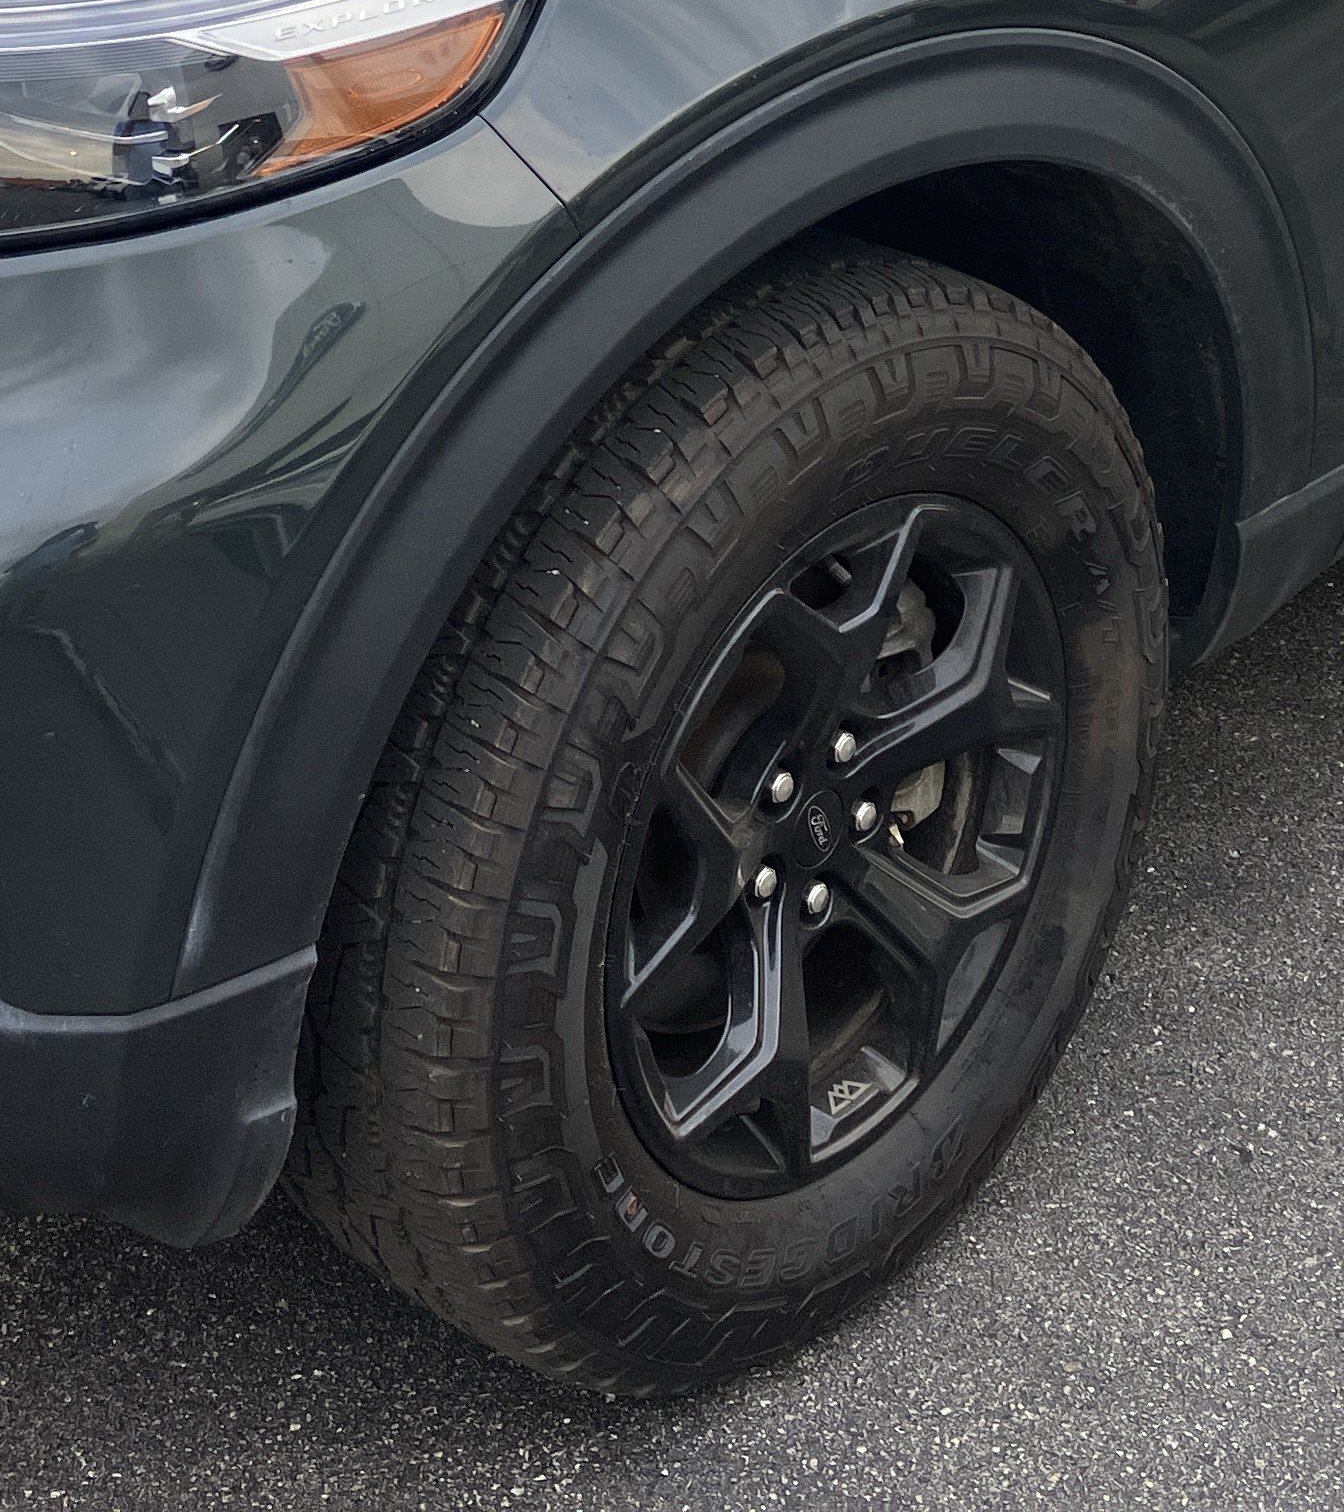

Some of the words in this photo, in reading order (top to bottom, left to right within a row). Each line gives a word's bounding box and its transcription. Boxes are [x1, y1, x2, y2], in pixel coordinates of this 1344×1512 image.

[833, 422, 1097, 542] DUELER
[810, 813, 829, 846] Ford
[593, 1116, 964, 1288] BRIDGESTONE
